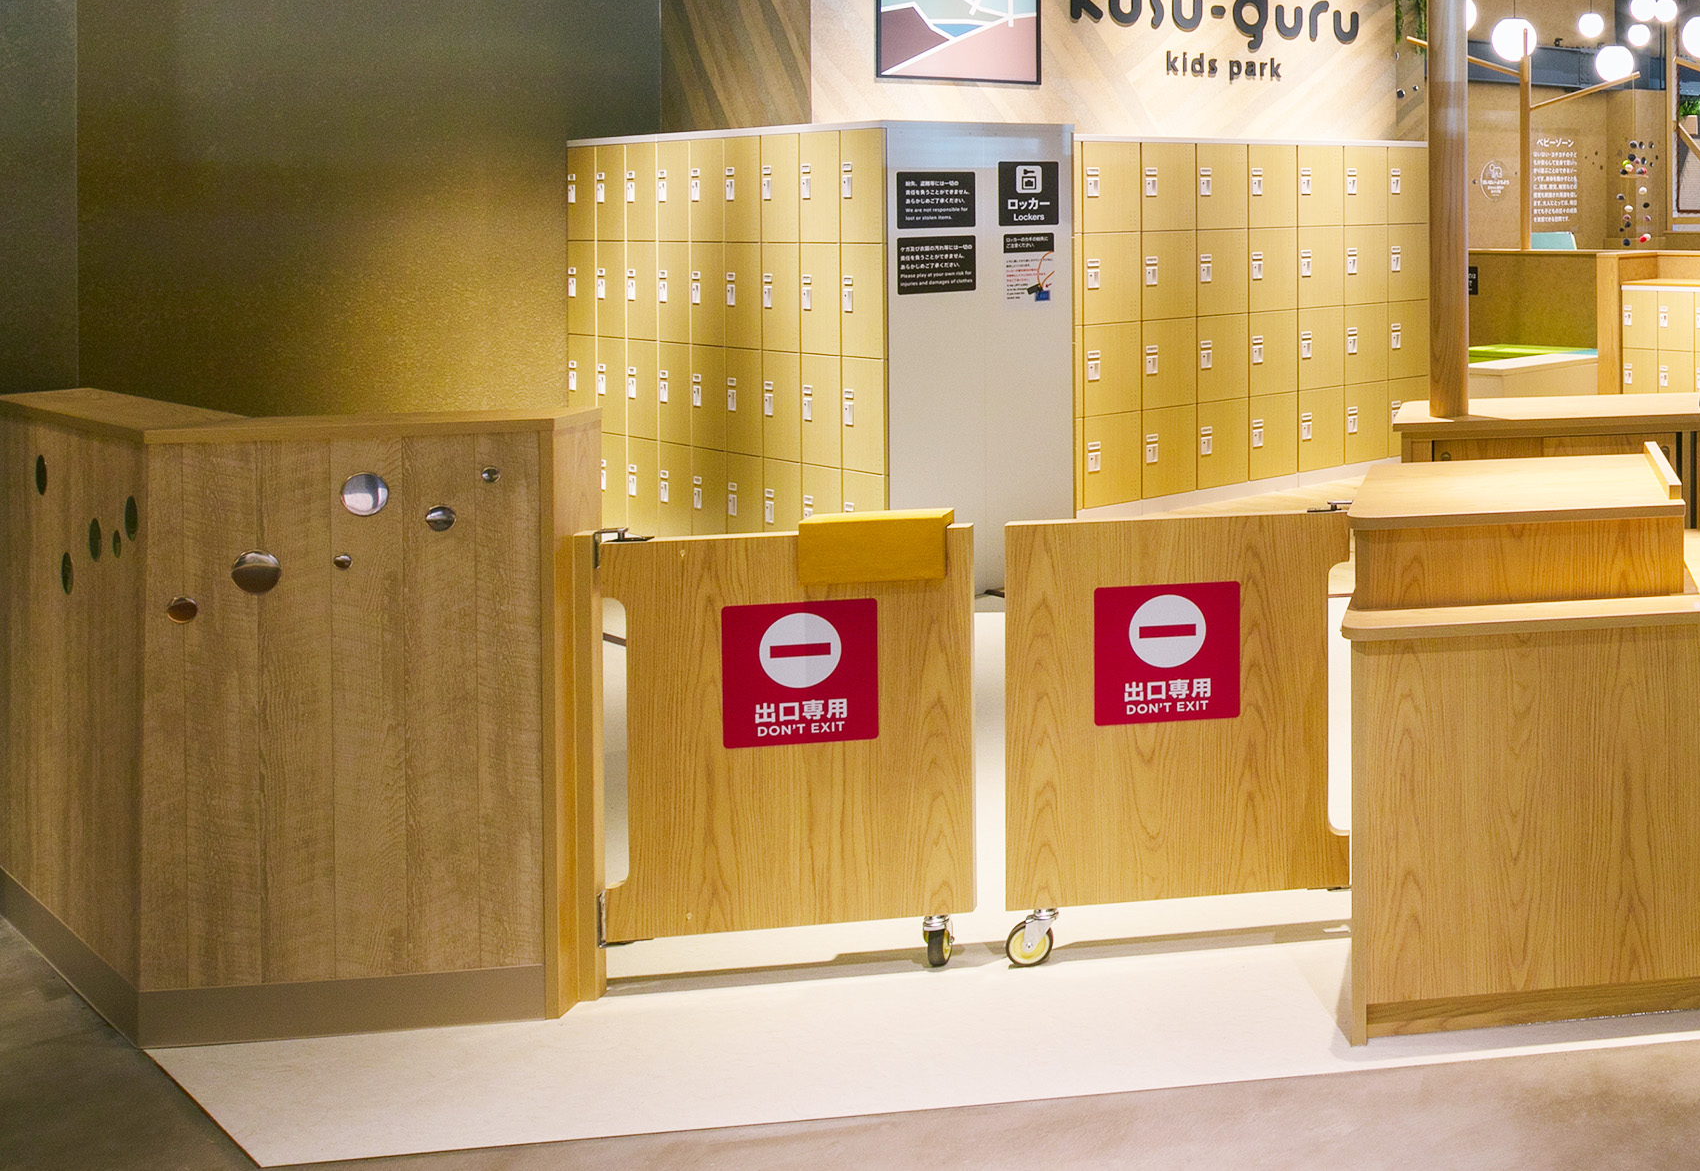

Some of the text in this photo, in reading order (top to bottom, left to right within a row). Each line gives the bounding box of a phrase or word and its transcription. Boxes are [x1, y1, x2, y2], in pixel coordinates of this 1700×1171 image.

[1166, 50, 1282, 83] kids park
[1536, 137, 1575, 148] ベビーゾーン
[1007, 197, 1051, 210] ロッカー
[1013, 213, 1045, 221] Lockers
[1123, 677, 1212, 703] 出口専用
[754, 698, 848, 724] 出口専用
[1126, 700, 1210, 715] DON'T EXIT
[757, 721, 846, 738] DON'T EXIT
